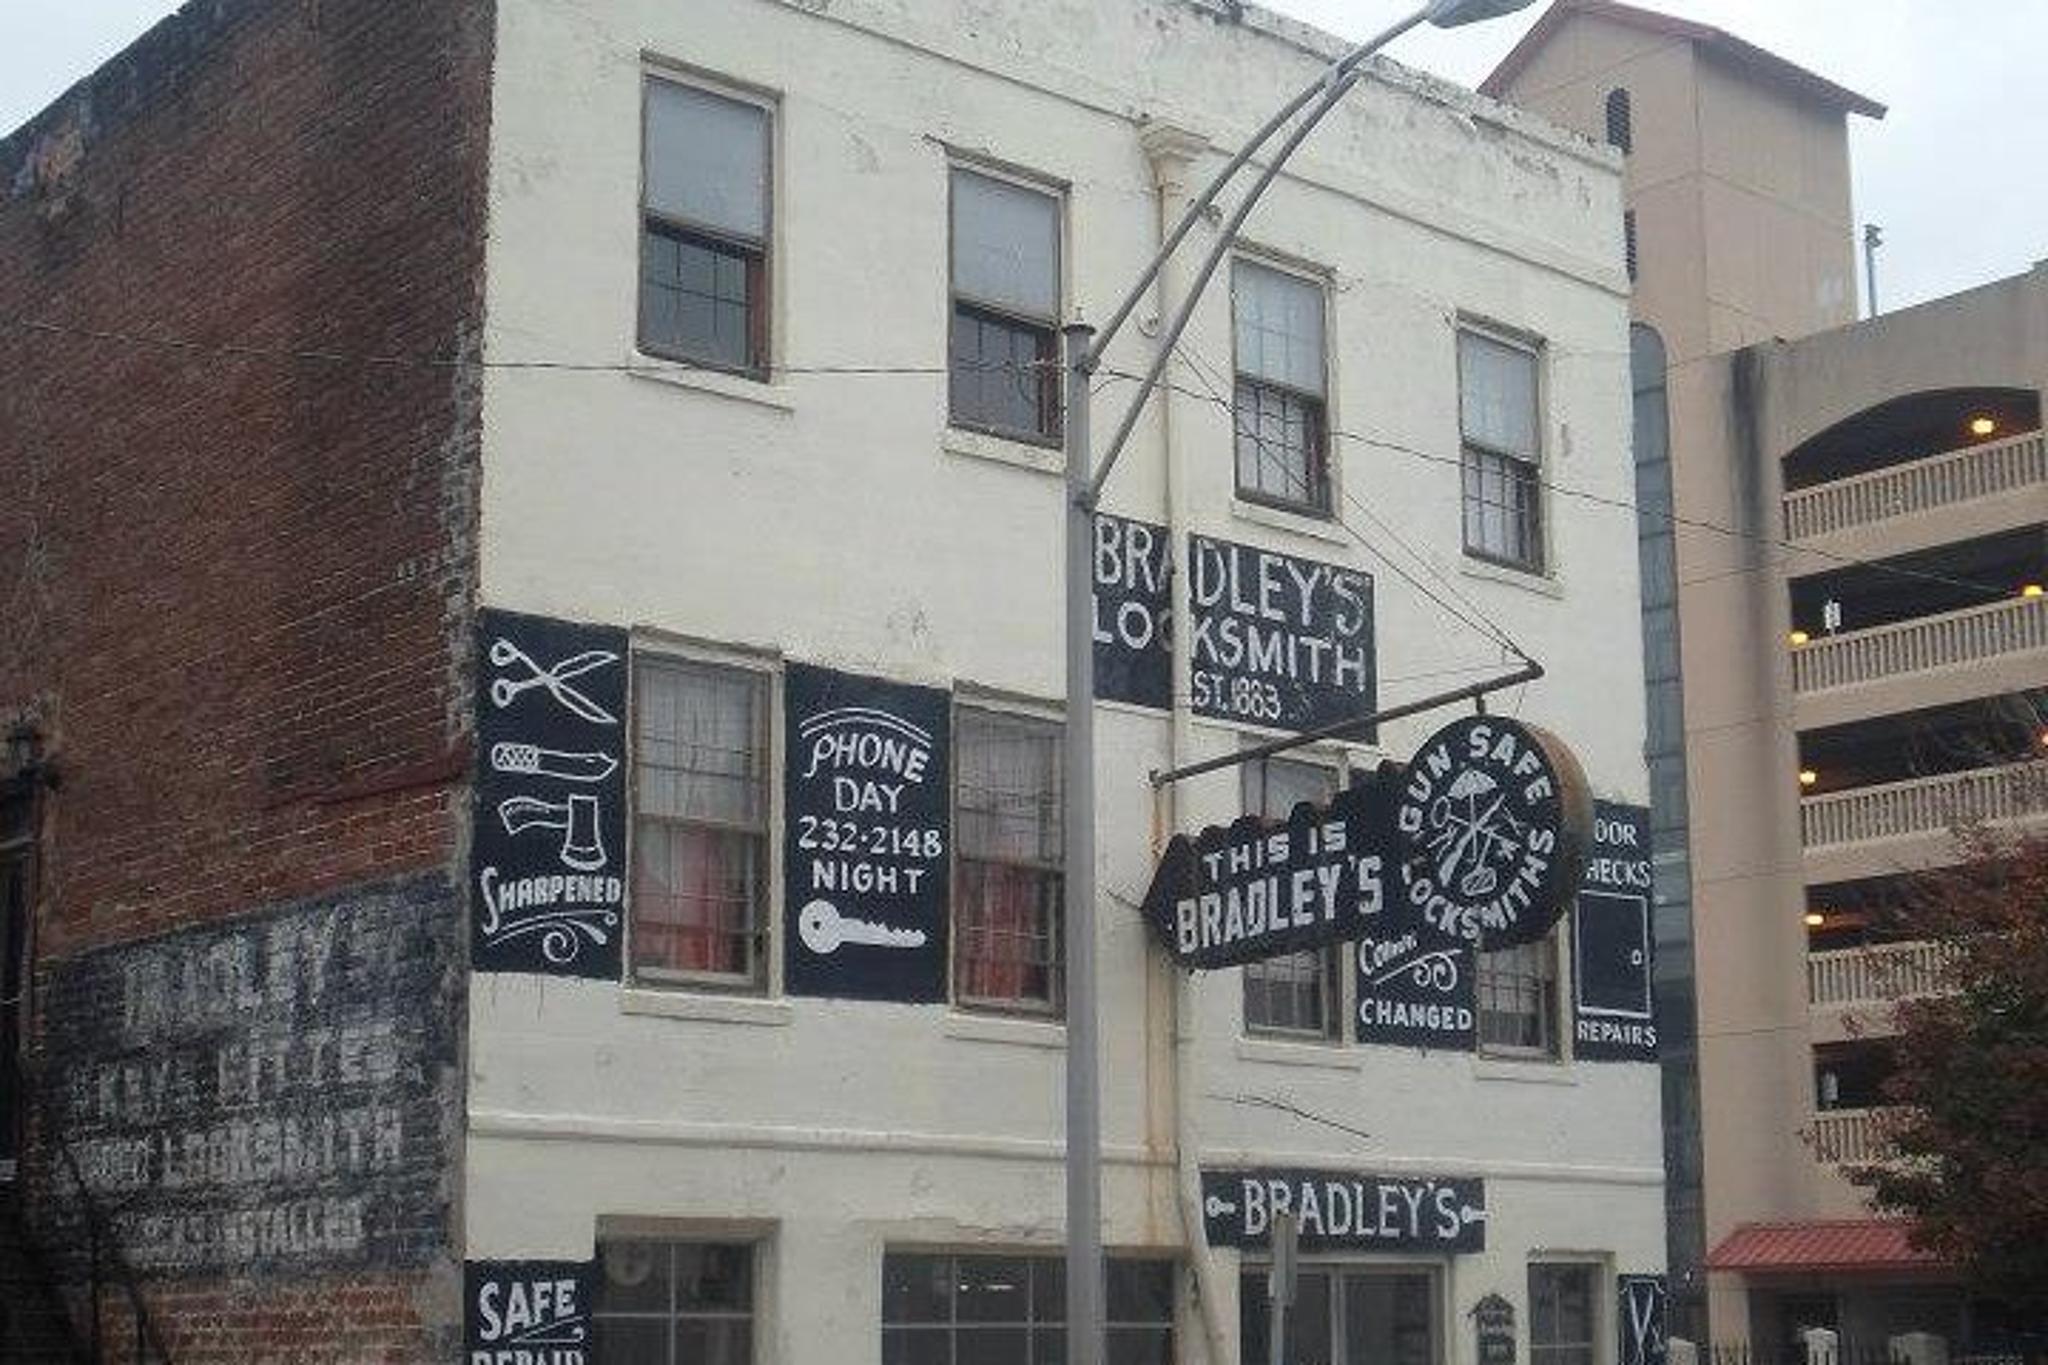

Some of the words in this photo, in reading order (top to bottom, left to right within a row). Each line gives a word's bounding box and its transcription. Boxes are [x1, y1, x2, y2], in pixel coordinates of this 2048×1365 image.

[805, 732, 929, 783] PHONE
[1399, 744, 1451, 832] GUN
[1469, 725, 1553, 805] SAFE
[834, 776, 905, 814] DAY
[1203, 833, 1289, 881] THIS
[1309, 821, 1346, 854] IS
[1594, 818, 1637, 847] OOR
[481, 866, 621, 933] SHARPENED
[812, 859, 925, 895] NIGHT
[1401, 829, 1554, 939] LOCKSMITHS
[1586, 858, 1651, 887] HECKS
[1177, 855, 1382, 954] BRADLEY'S
[1360, 998, 1471, 1030] CHANGED
[1577, 1020, 1656, 1048] REPAIRS
[1243, 1179, 1460, 1238] BRADLEY'S
[480, 1279, 576, 1340] SAFE
